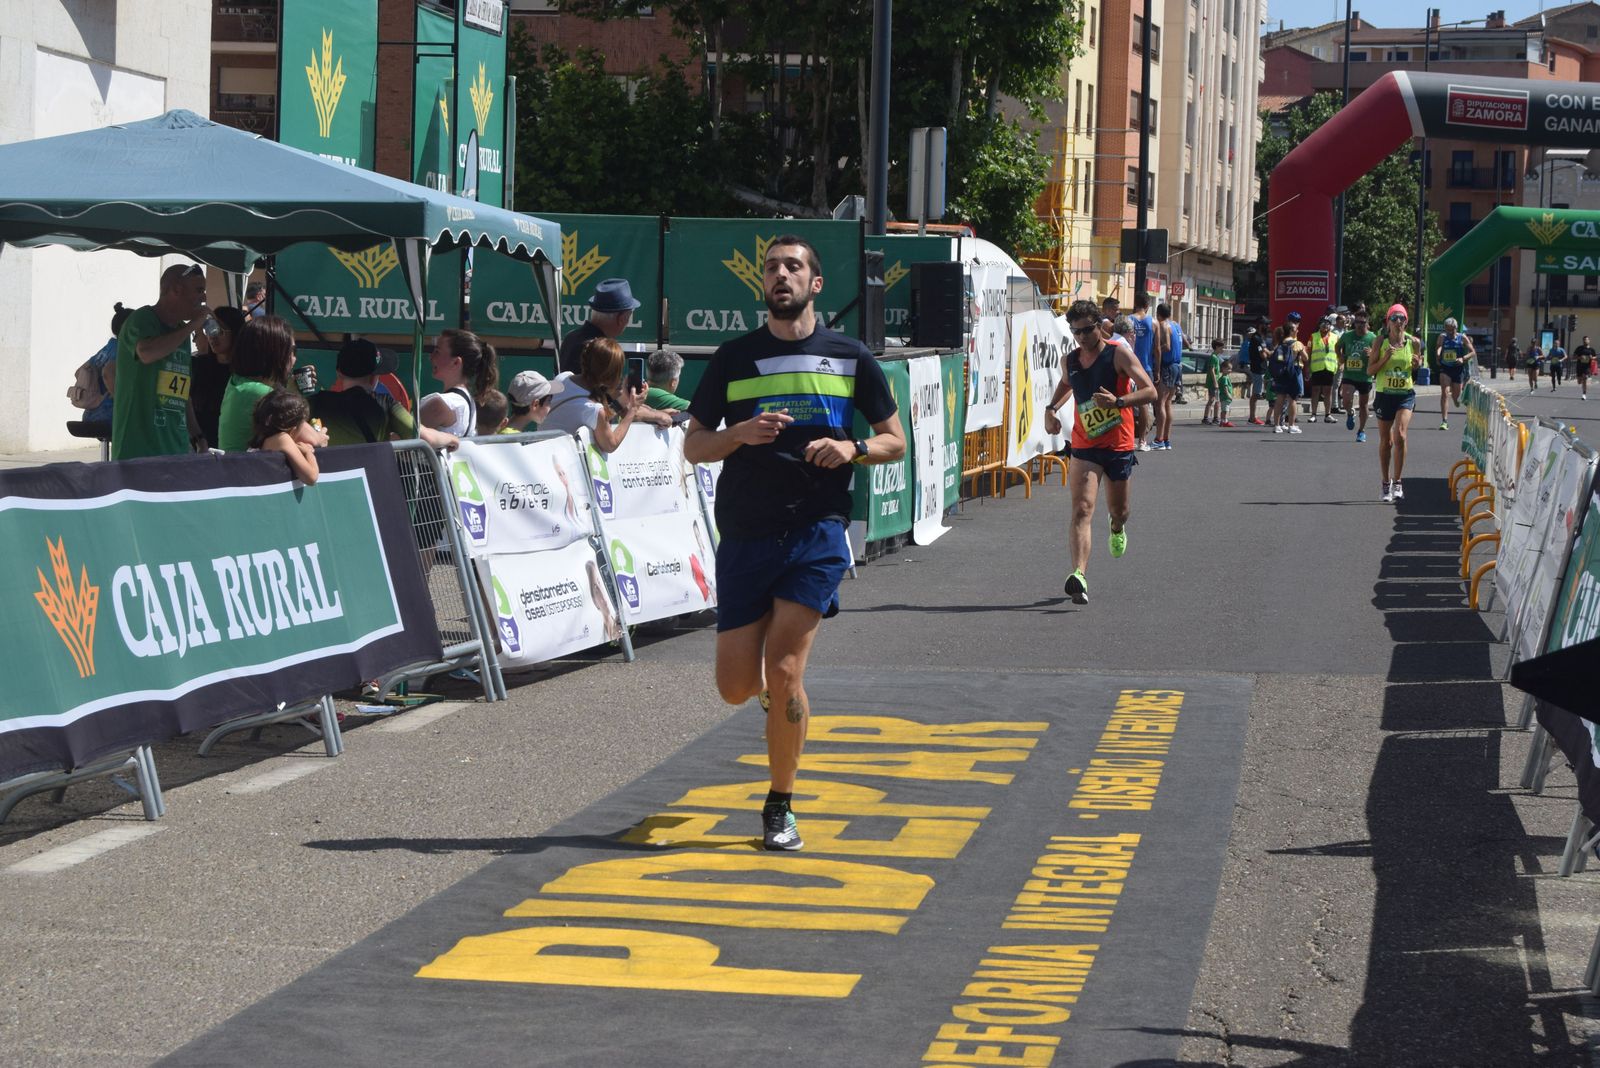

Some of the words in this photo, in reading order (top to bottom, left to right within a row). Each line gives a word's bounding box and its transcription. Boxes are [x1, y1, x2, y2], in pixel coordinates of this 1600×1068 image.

[1546, 94, 1586, 111] CON
[1466, 108, 1523, 122] ZAMORA
[479, 148, 501, 173] RURAL
[1286, 286, 1326, 294] ZAMORA
[293, 294, 351, 318] CAJA
[486, 300, 549, 322] CAJA
[560, 304, 643, 328] RUL
[685, 308, 748, 332] CAJA
[169, 375, 187, 395] 47
[1387, 377, 1406, 387] 103
[1084, 408, 1115, 428] 202
[112, 563, 221, 658] CAJA
[211, 542, 344, 640] RURAL
[1094, 689, 1185, 755] INTERIORES
[1066, 758, 1166, 810] DISEÑO
[414, 714, 1051, 998] PIDEPAR
[1001, 833, 1142, 932] INTEGRAL
[921, 943, 1101, 1068] EFORMA
